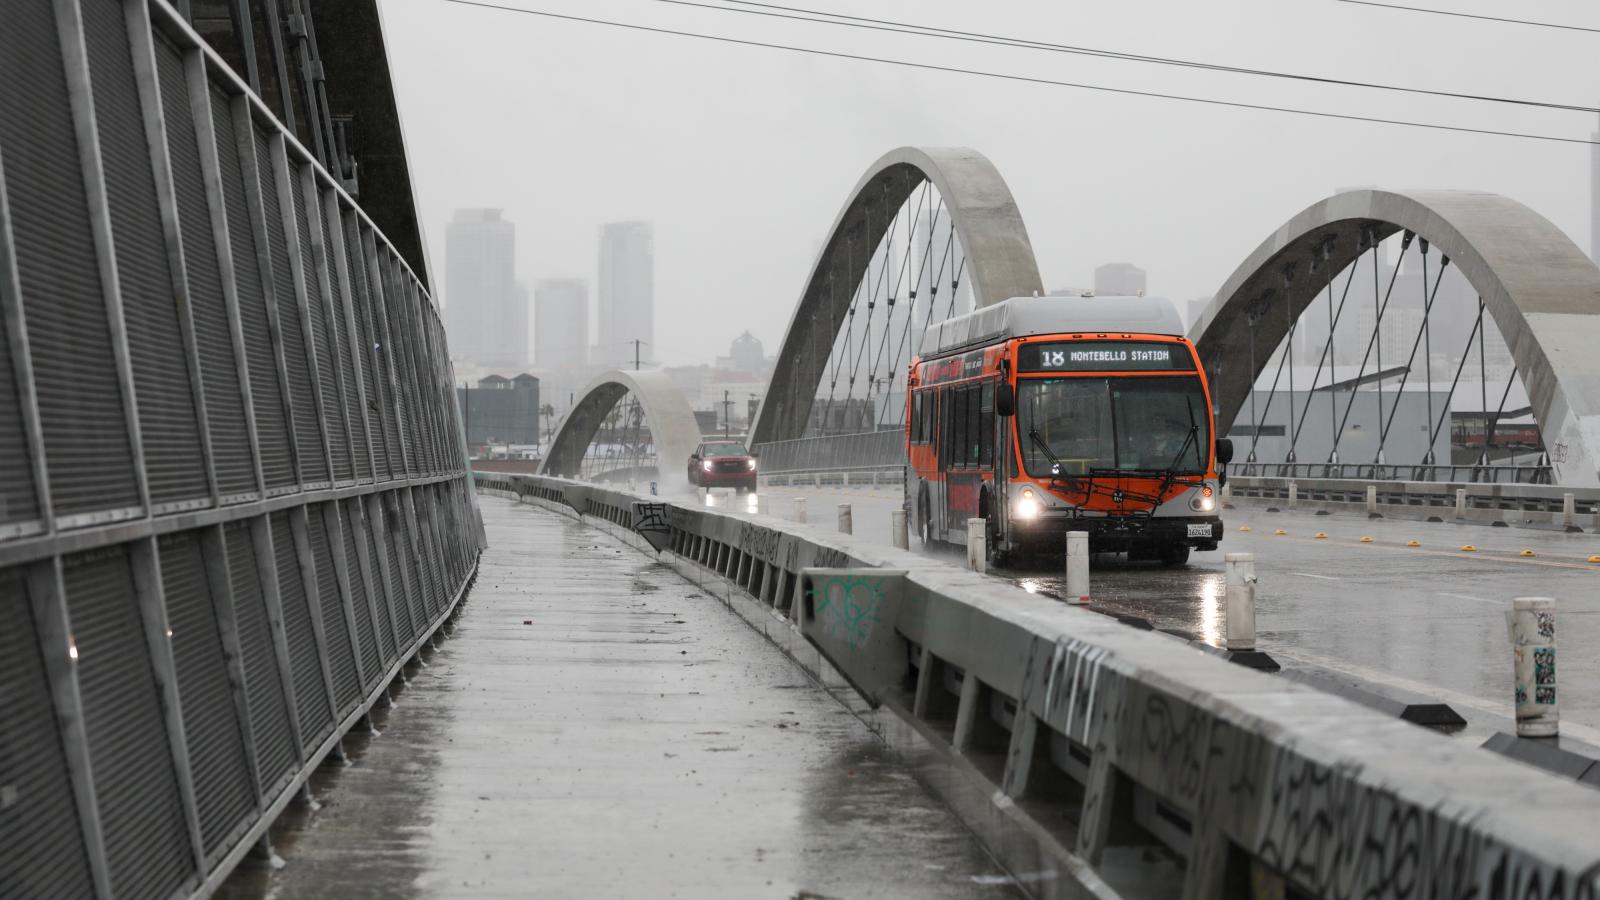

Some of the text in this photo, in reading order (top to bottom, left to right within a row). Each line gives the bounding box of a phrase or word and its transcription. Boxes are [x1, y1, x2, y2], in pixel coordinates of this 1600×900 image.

[1042, 350, 1169, 367] 18 MONTEBELLO STATION
